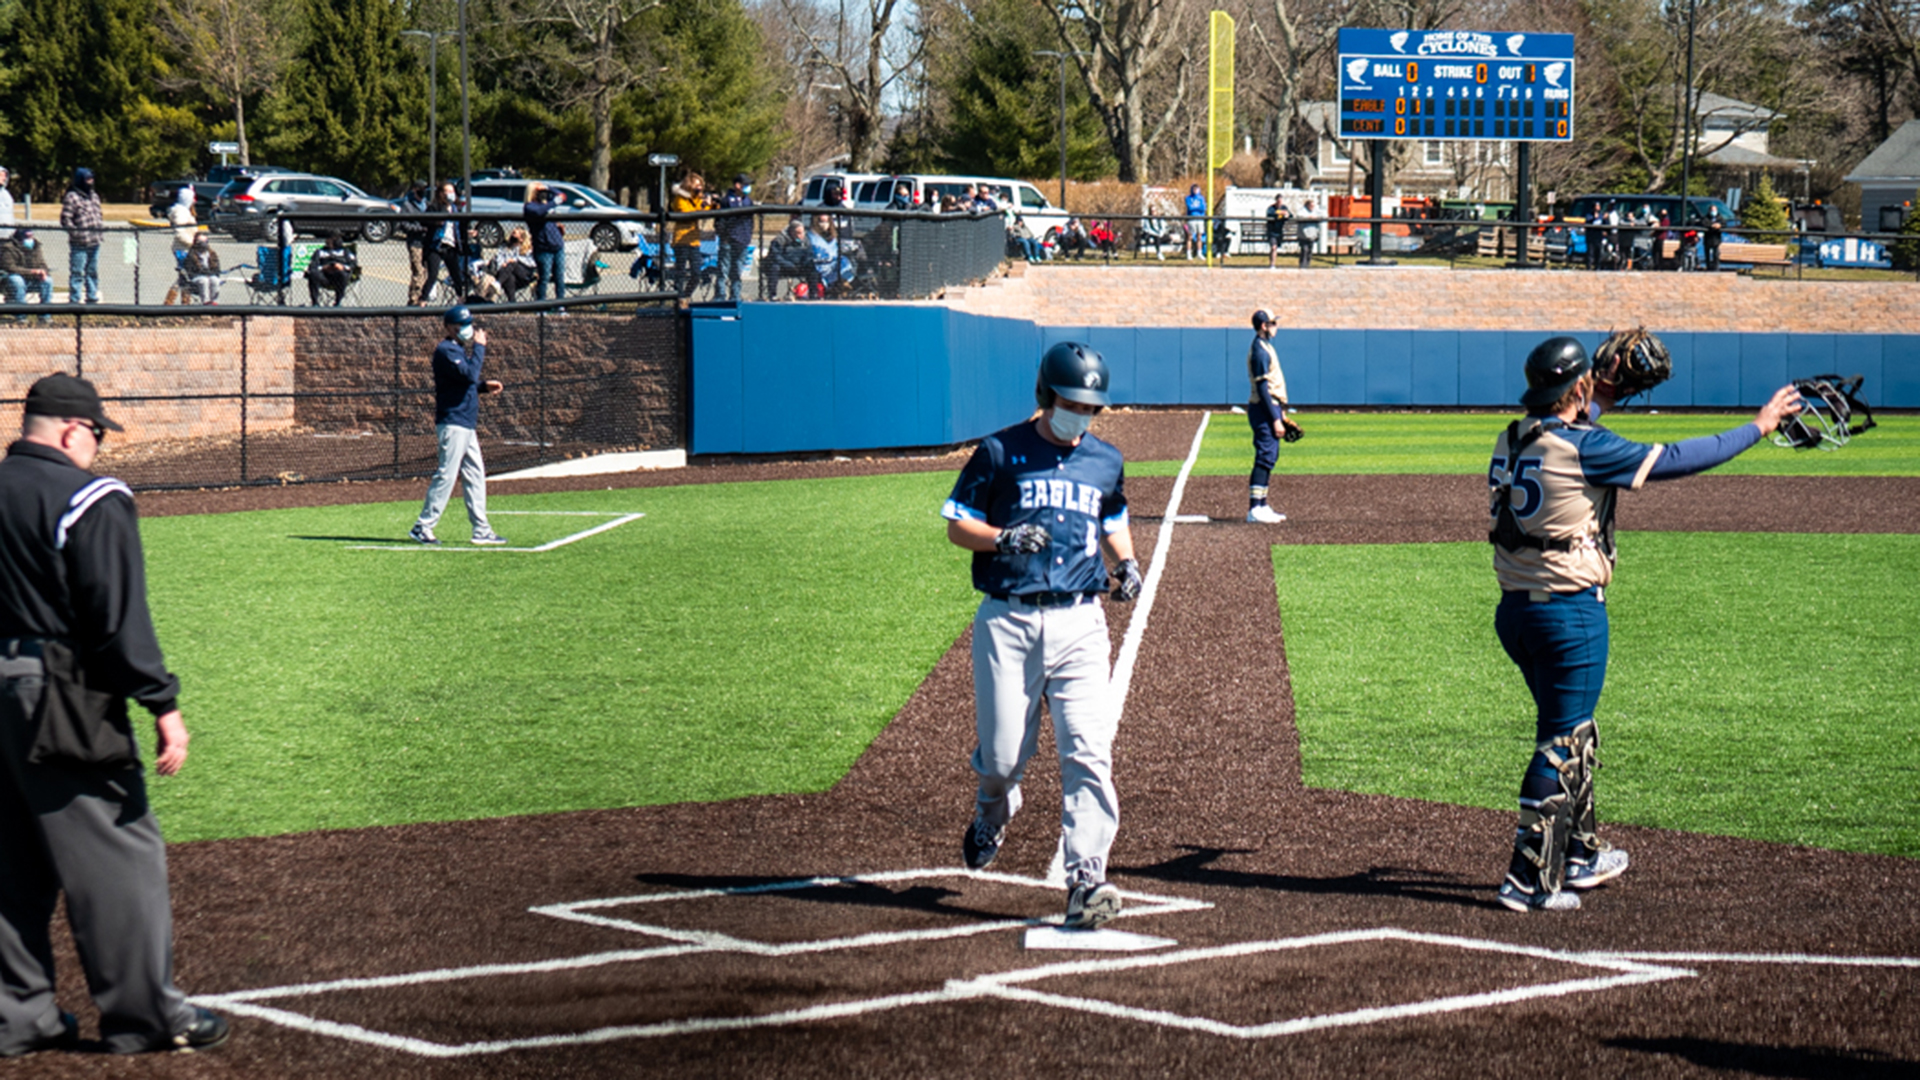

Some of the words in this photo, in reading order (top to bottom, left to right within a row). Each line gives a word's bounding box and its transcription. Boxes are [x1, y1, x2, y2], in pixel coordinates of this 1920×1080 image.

[1424, 32, 1453, 43] HOME
[1456, 32, 1470, 41] OF
[1472, 33, 1492, 44] THE
[1417, 40, 1498, 57] CYCLONES
[1373, 64, 1403, 78] BALL
[1406, 62, 1418, 83] 0
[1434, 65, 1474, 79] STRIKE
[1476, 63, 1488, 84] 0
[1498, 65, 1523, 80] OUT
[1399, 86, 1405, 98] 1
[1412, 86, 1419, 98] 2
[1426, 86, 1434, 98] 3
[1447, 86, 1455, 98] 4
[1461, 86, 1469, 98] 5
[1476, 86, 1484, 99] 6
[1511, 87, 1518, 99] 8
[1544, 88, 1570, 99] RUNS
[1395, 98, 1406, 115] 0
[1353, 119, 1381, 132] CENT
[1395, 118, 1406, 135] 0
[1557, 120, 1568, 137] 0
